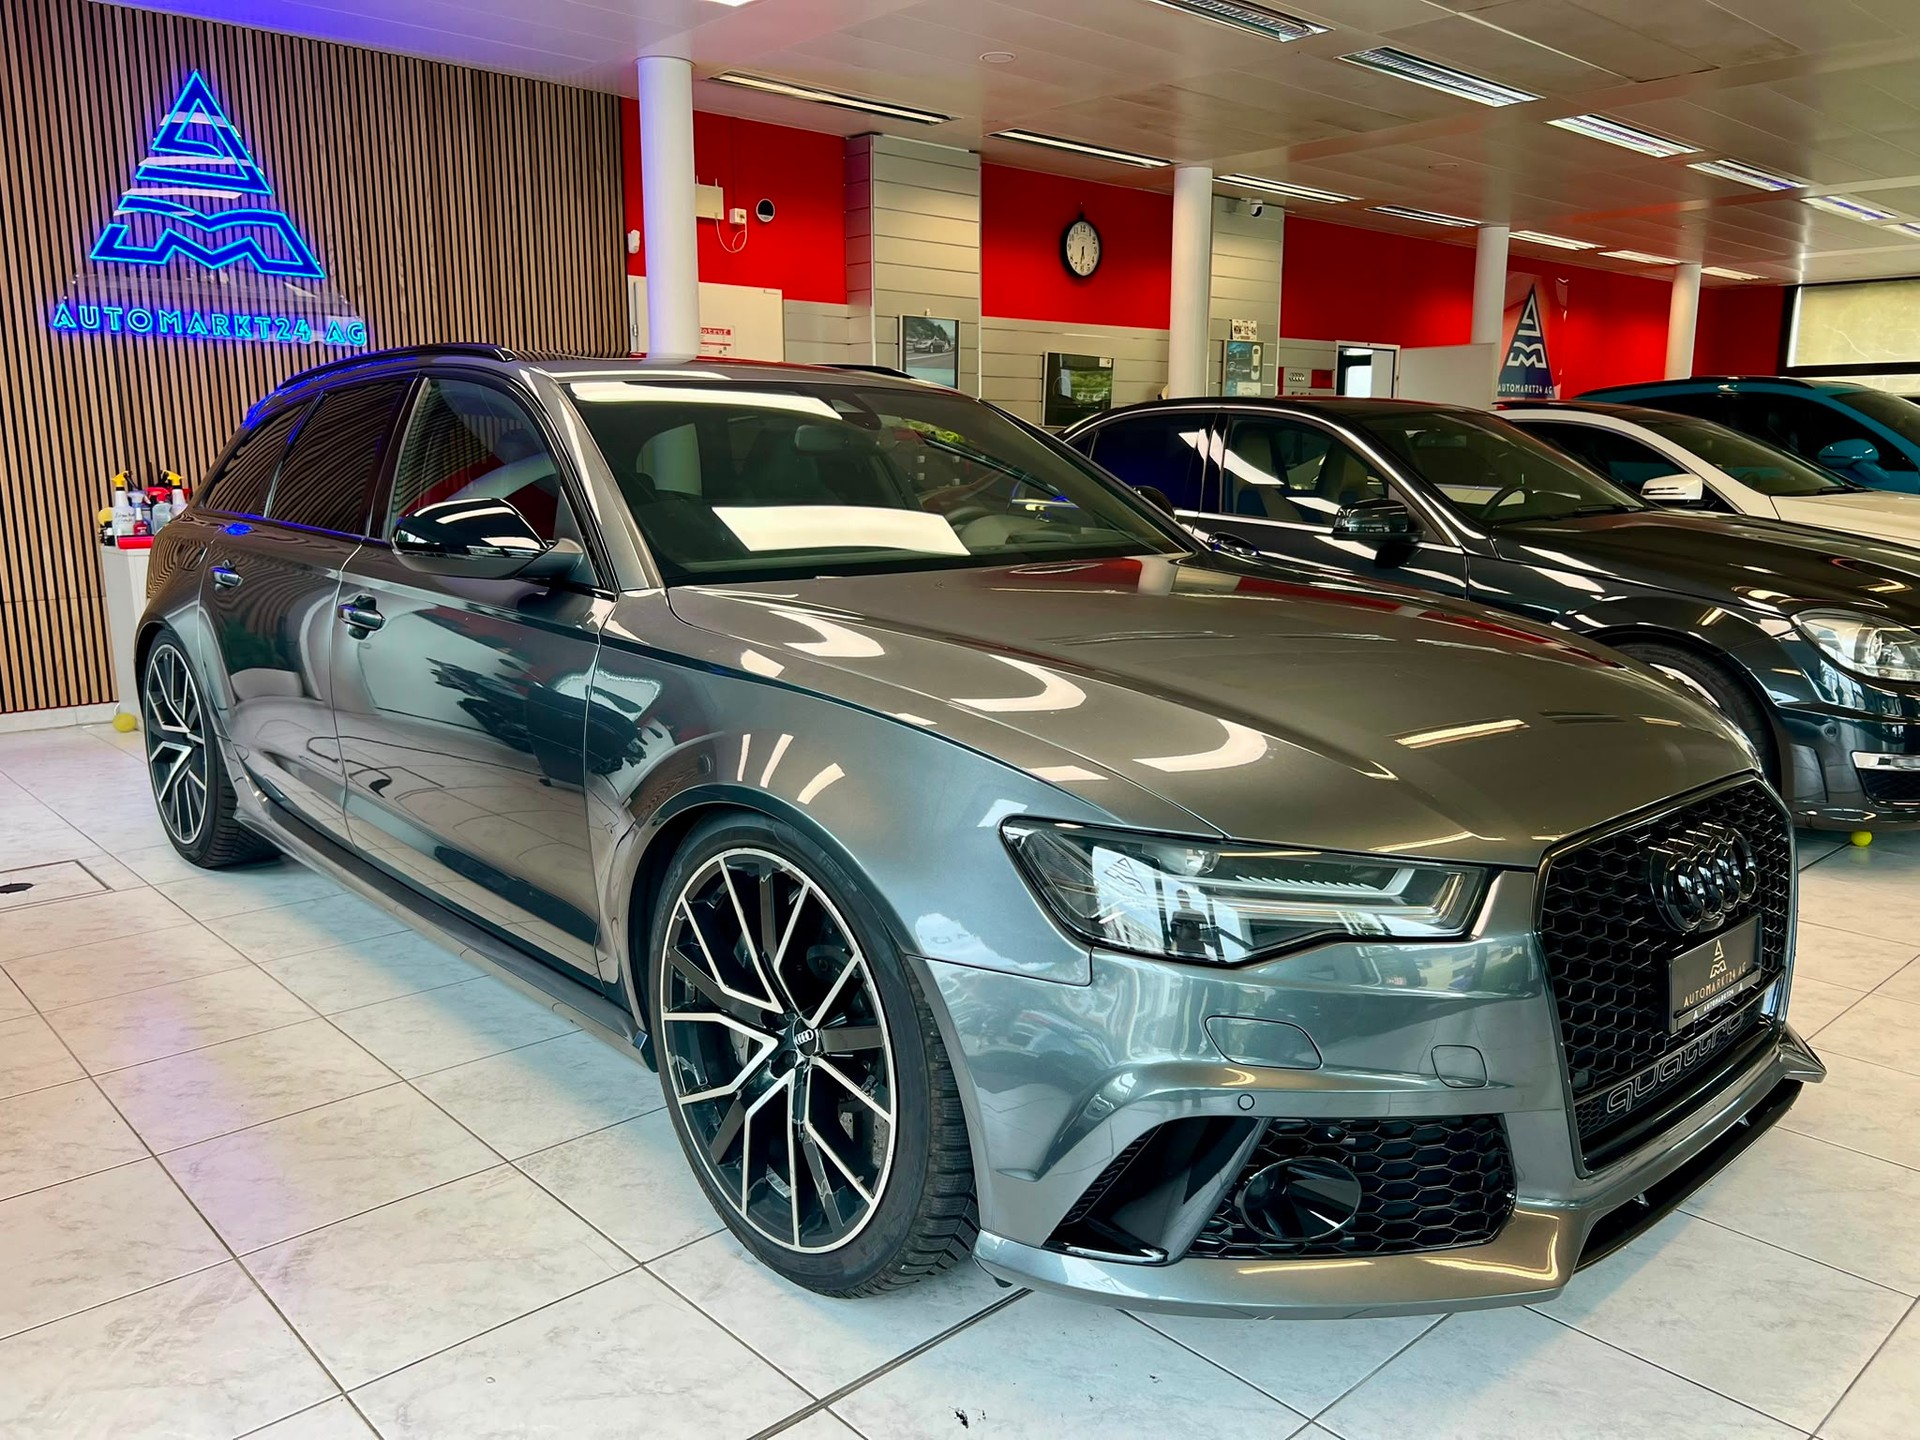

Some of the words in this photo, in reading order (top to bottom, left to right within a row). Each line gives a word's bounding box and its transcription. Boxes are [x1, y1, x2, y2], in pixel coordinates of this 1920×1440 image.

[52, 302, 313, 342] AUTOMARKT24
[325, 320, 366, 346] AG
[1497, 383, 1543, 394] AUTOMARKT24
[1544, 386, 1553, 395] AG
[1683, 969, 1736, 1008] AUTOMARKT24
[1738, 961, 1747, 976] AG
[1607, 1012, 1744, 1114] quattro
